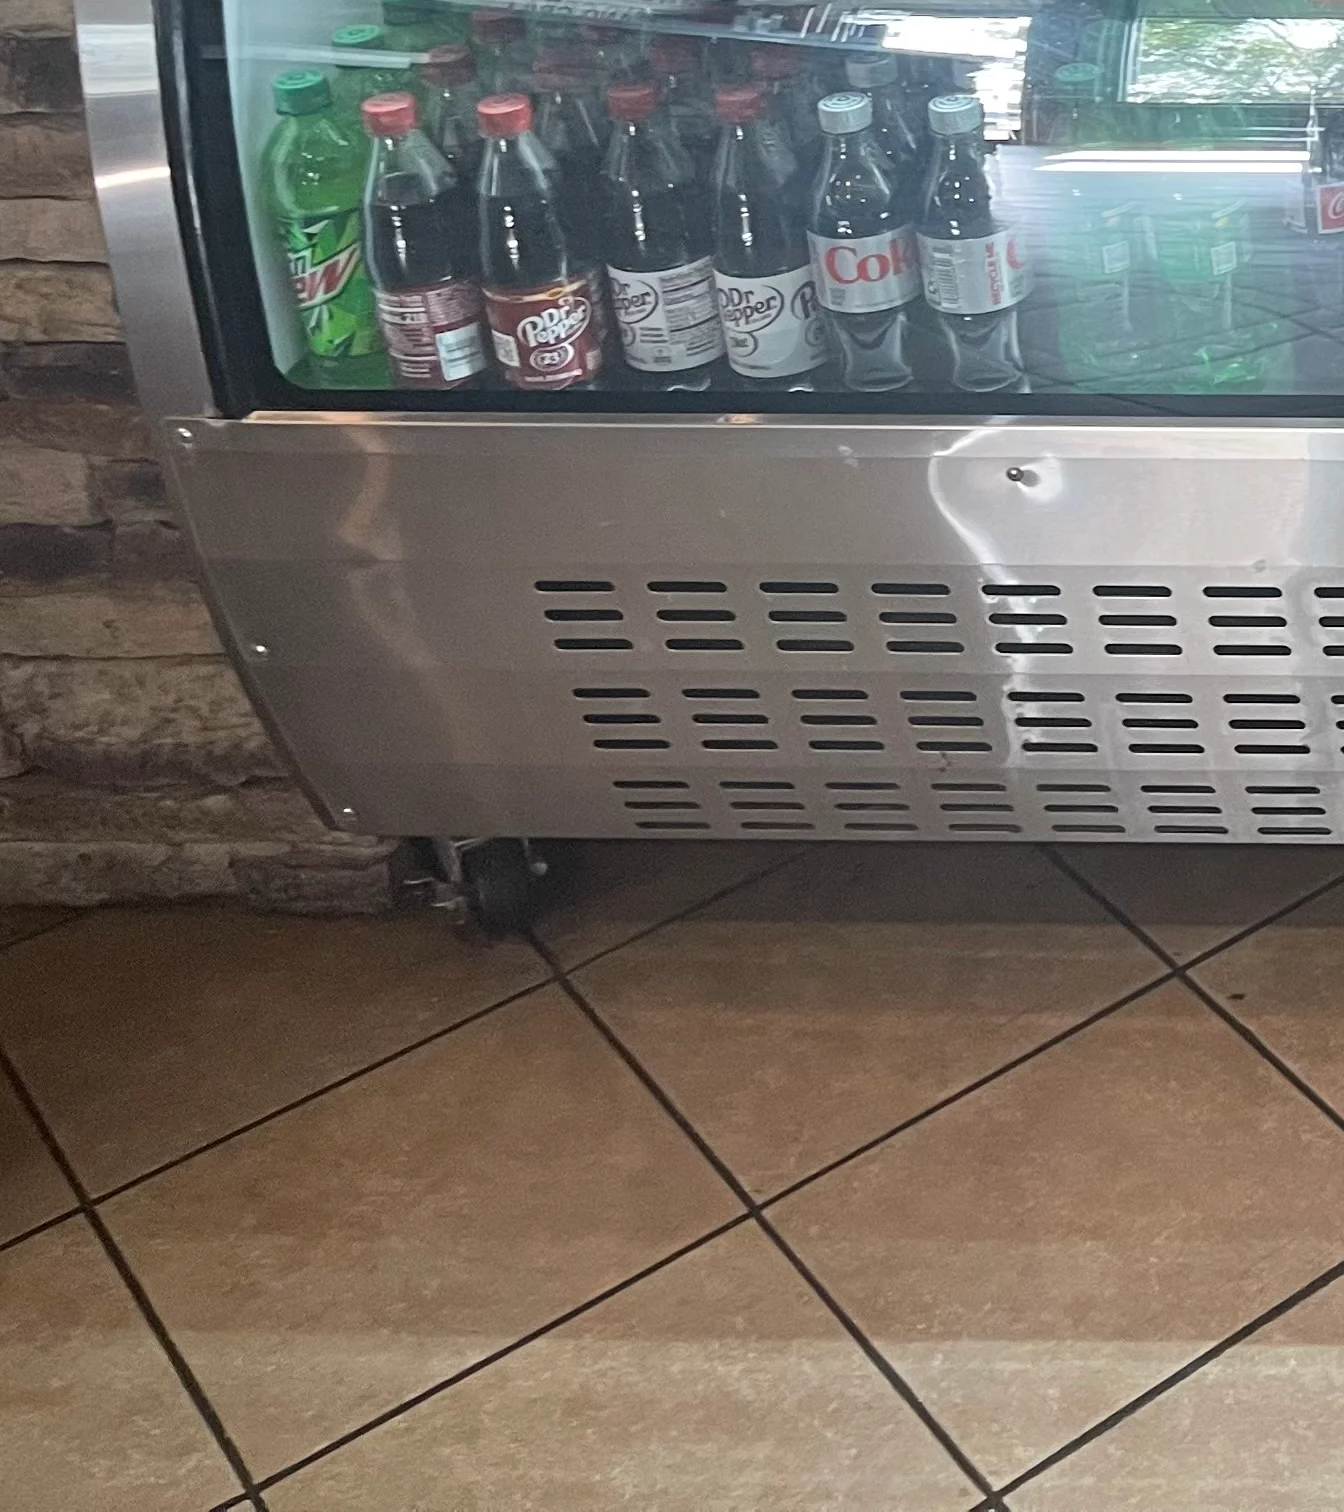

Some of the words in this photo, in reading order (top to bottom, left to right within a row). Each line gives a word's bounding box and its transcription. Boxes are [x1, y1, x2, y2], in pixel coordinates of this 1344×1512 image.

[727, 287, 756, 309] Dr
[518, 309, 588, 348] Pepper
[543, 304, 573, 330] Dr
